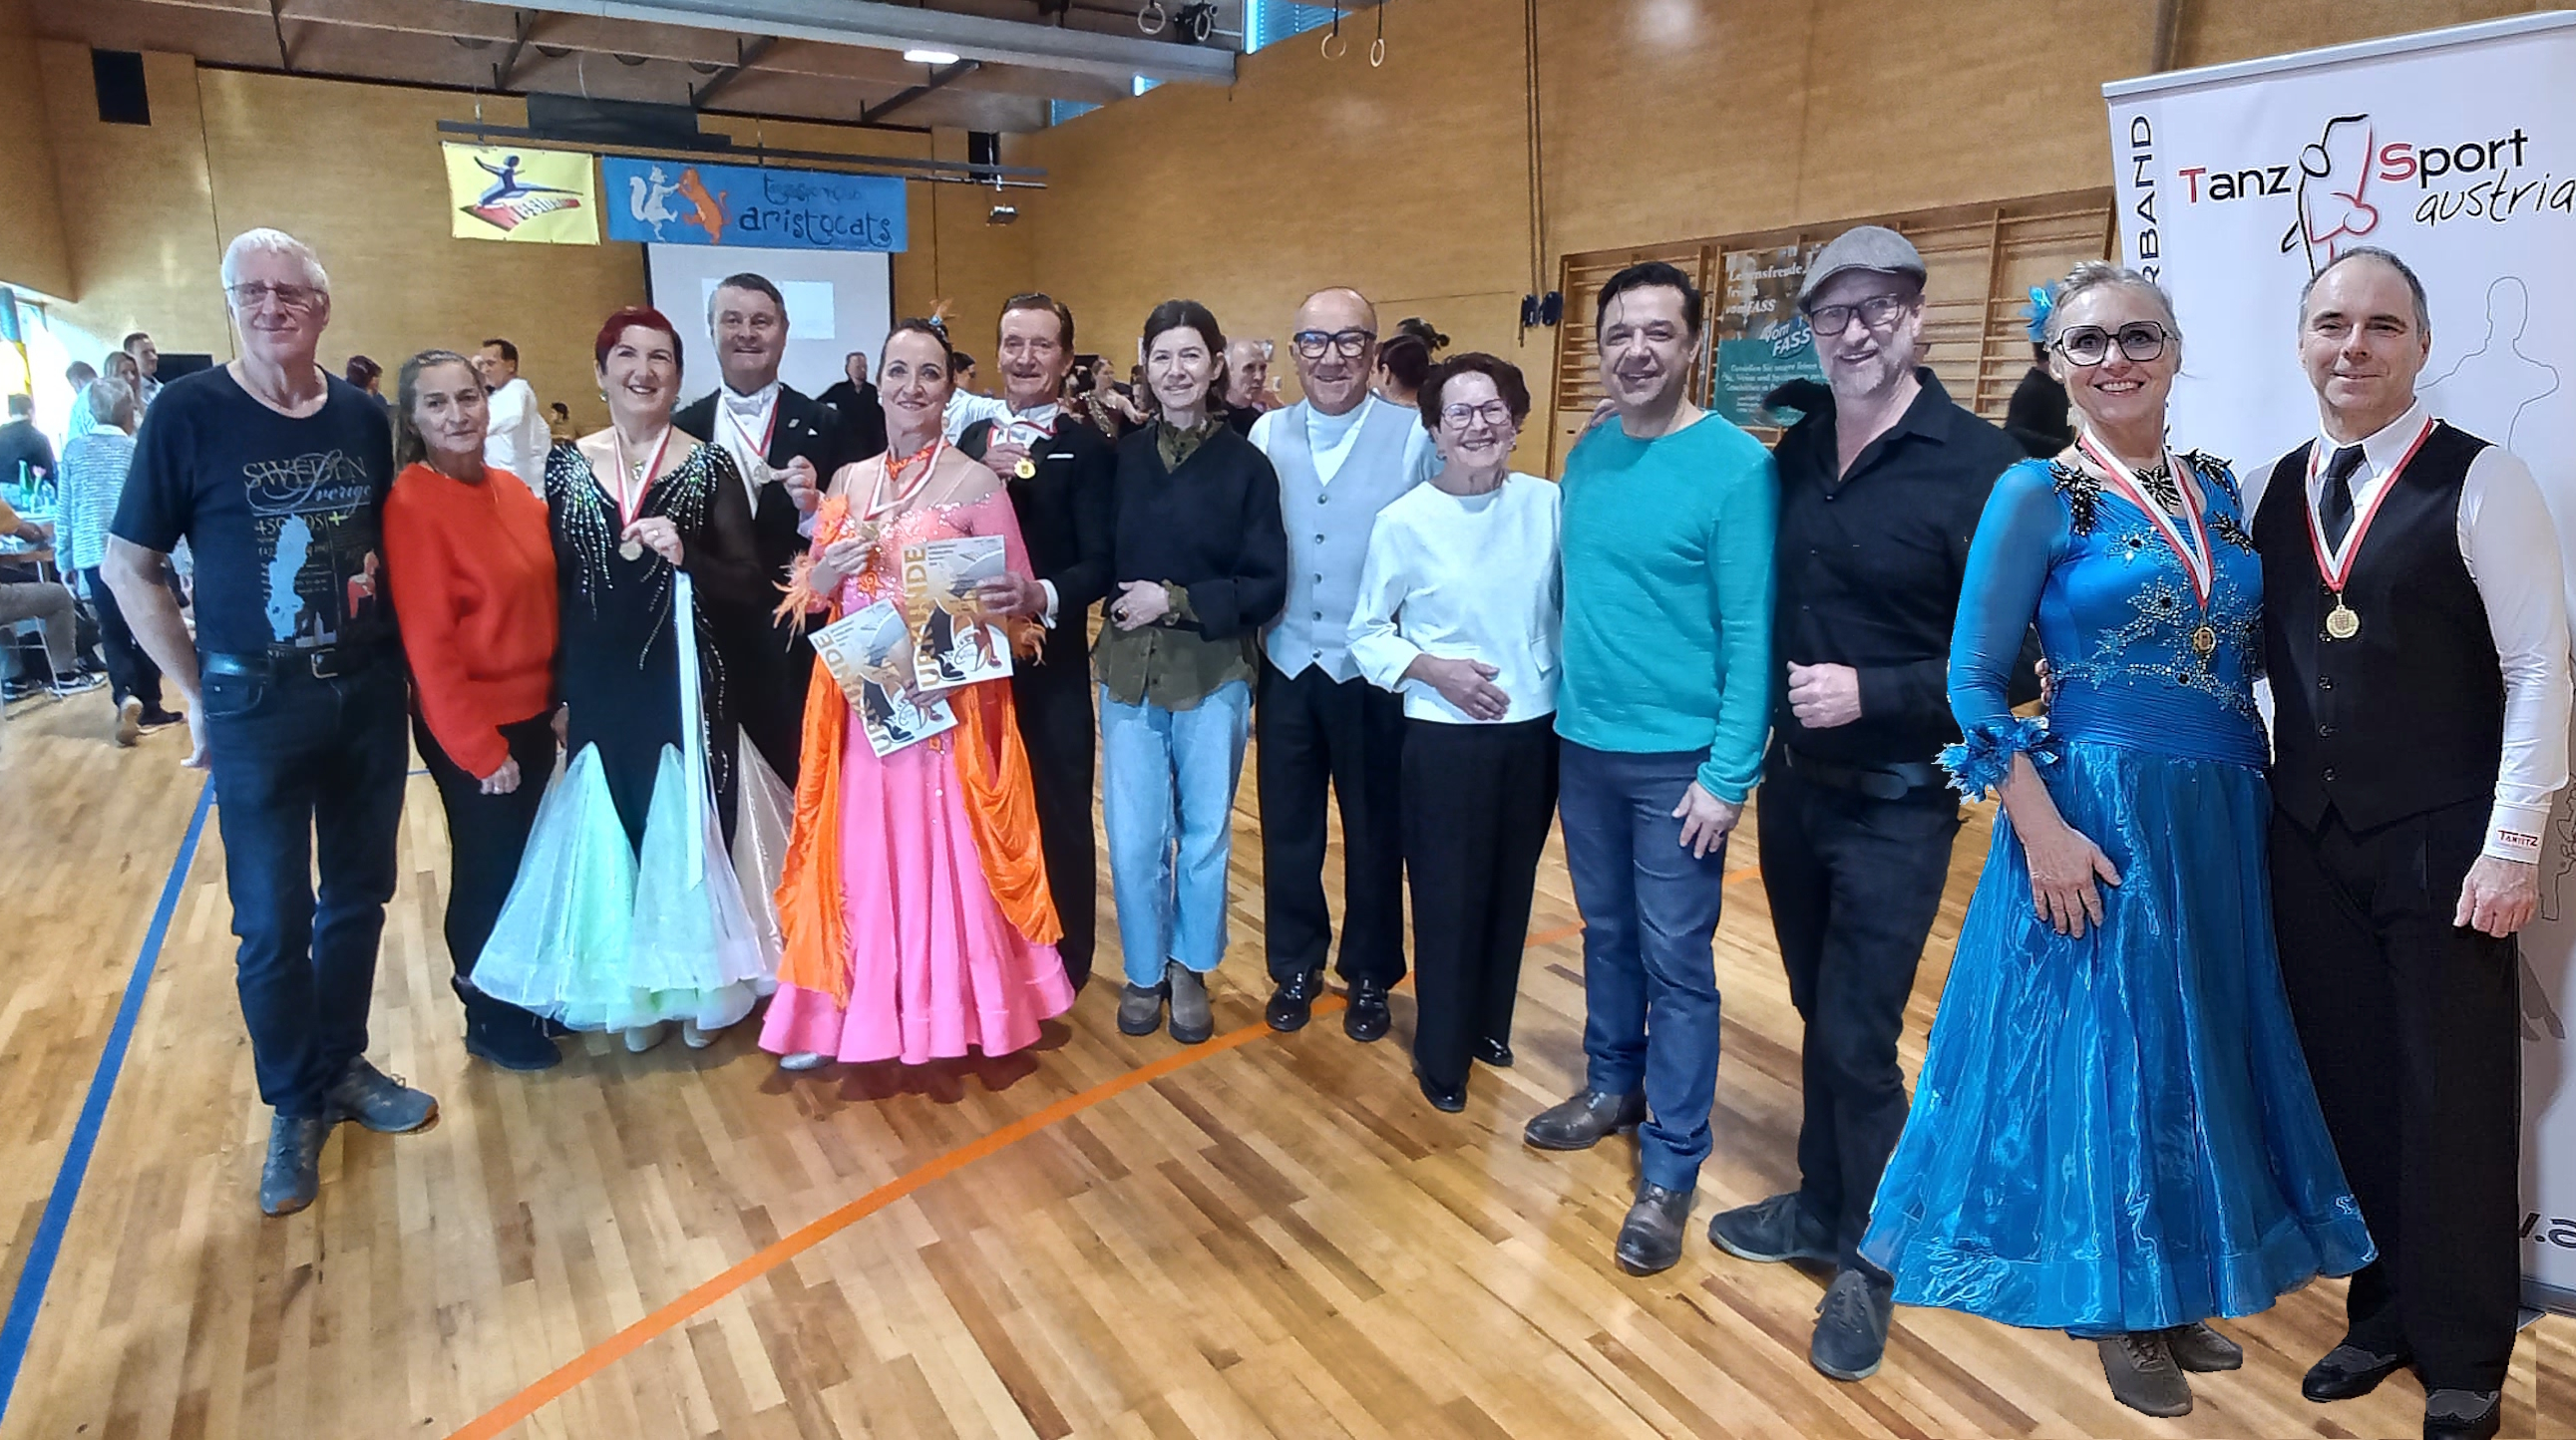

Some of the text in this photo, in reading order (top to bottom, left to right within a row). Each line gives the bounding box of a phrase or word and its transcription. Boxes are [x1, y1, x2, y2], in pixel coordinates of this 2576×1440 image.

[2178, 128, 2529, 203] Tanz Sport
[2415, 168, 2576, 227] austria
[739, 206, 893, 247] aristocats
[1772, 327, 1811, 357] FASS
[242, 457, 367, 488] SWEDEN
